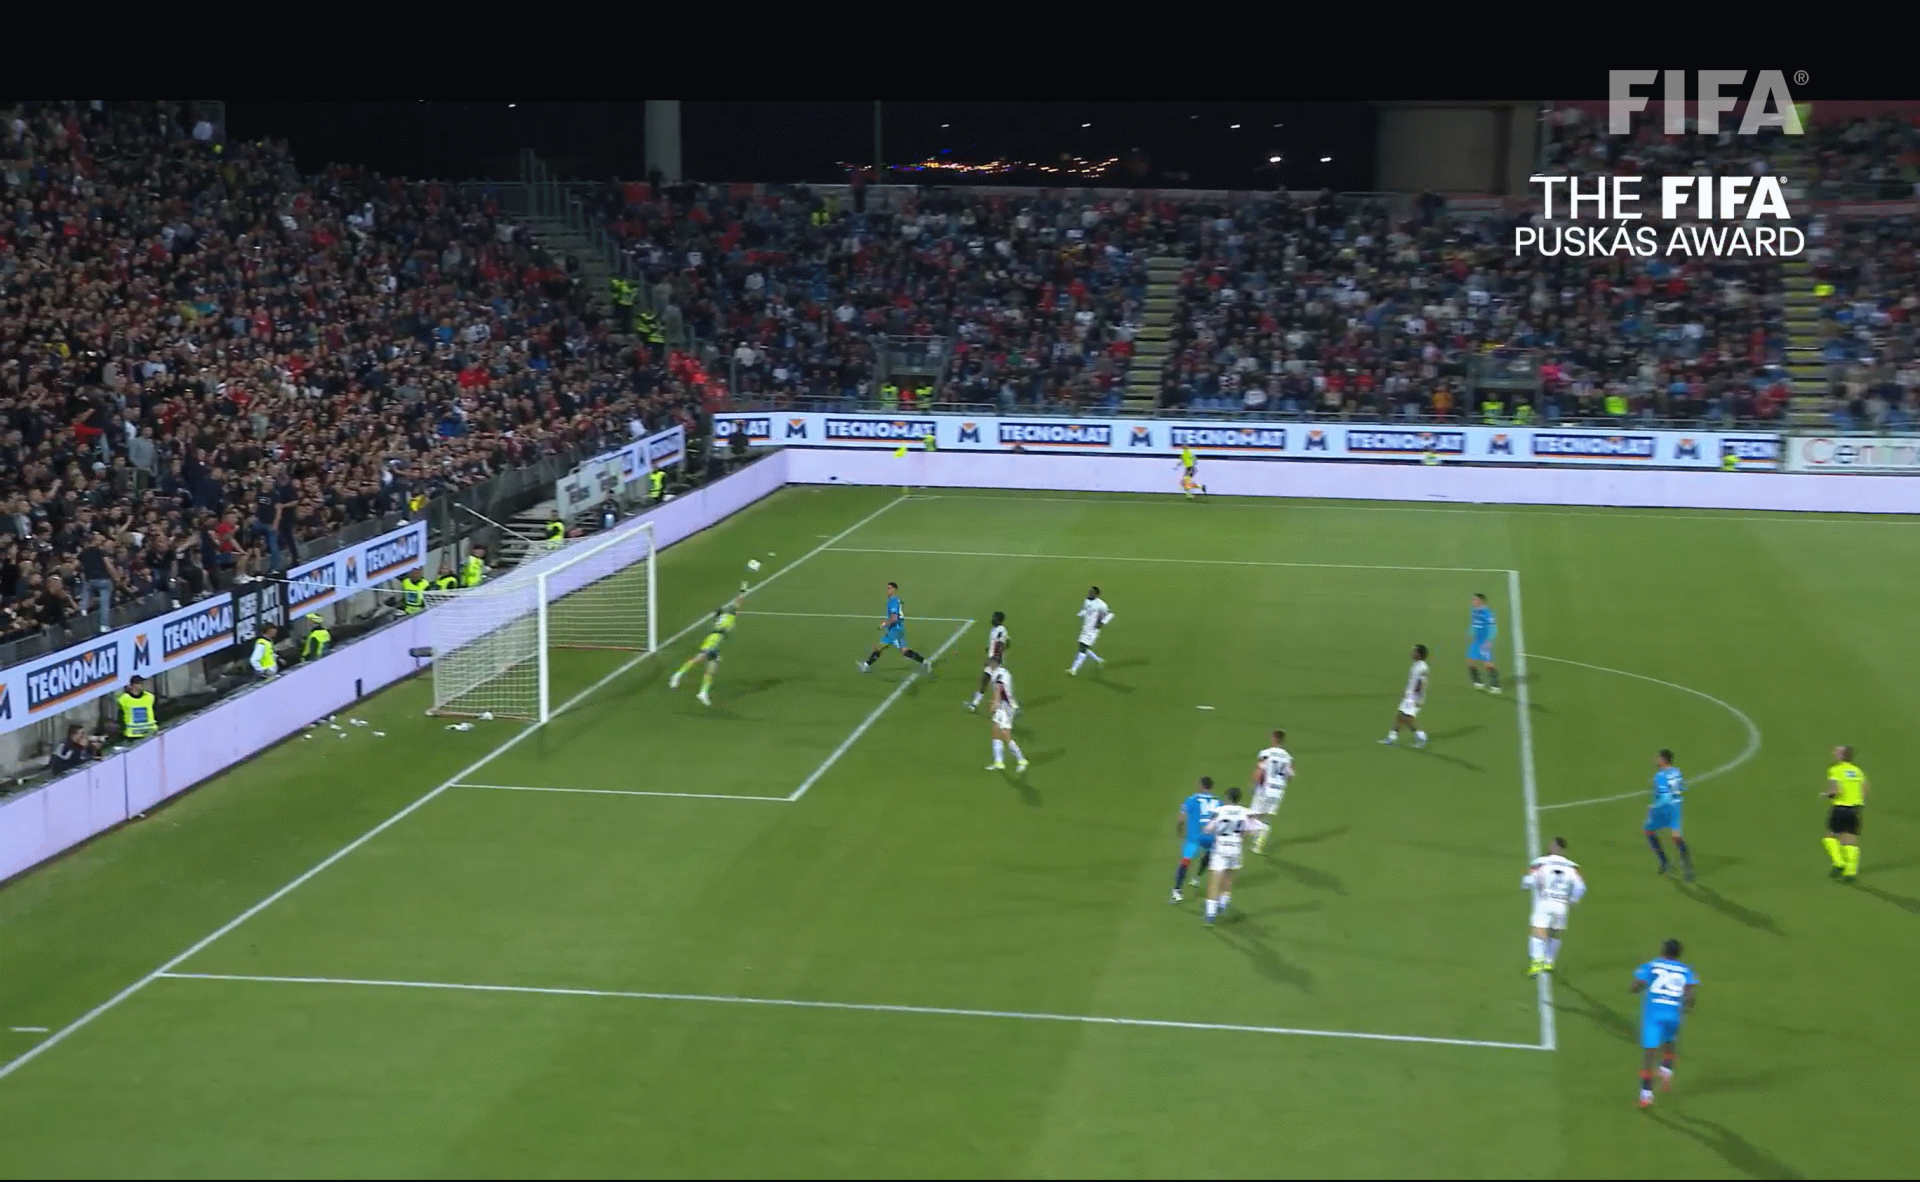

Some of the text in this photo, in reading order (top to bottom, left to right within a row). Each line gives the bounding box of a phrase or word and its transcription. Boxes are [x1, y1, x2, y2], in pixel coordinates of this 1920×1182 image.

[827, 420, 935, 438] TECNOMAT
[1002, 424, 1110, 443] TECNOMAT
[1172, 427, 1282, 447] TECNOMAT
[28, 647, 117, 704] TECNOMAT
